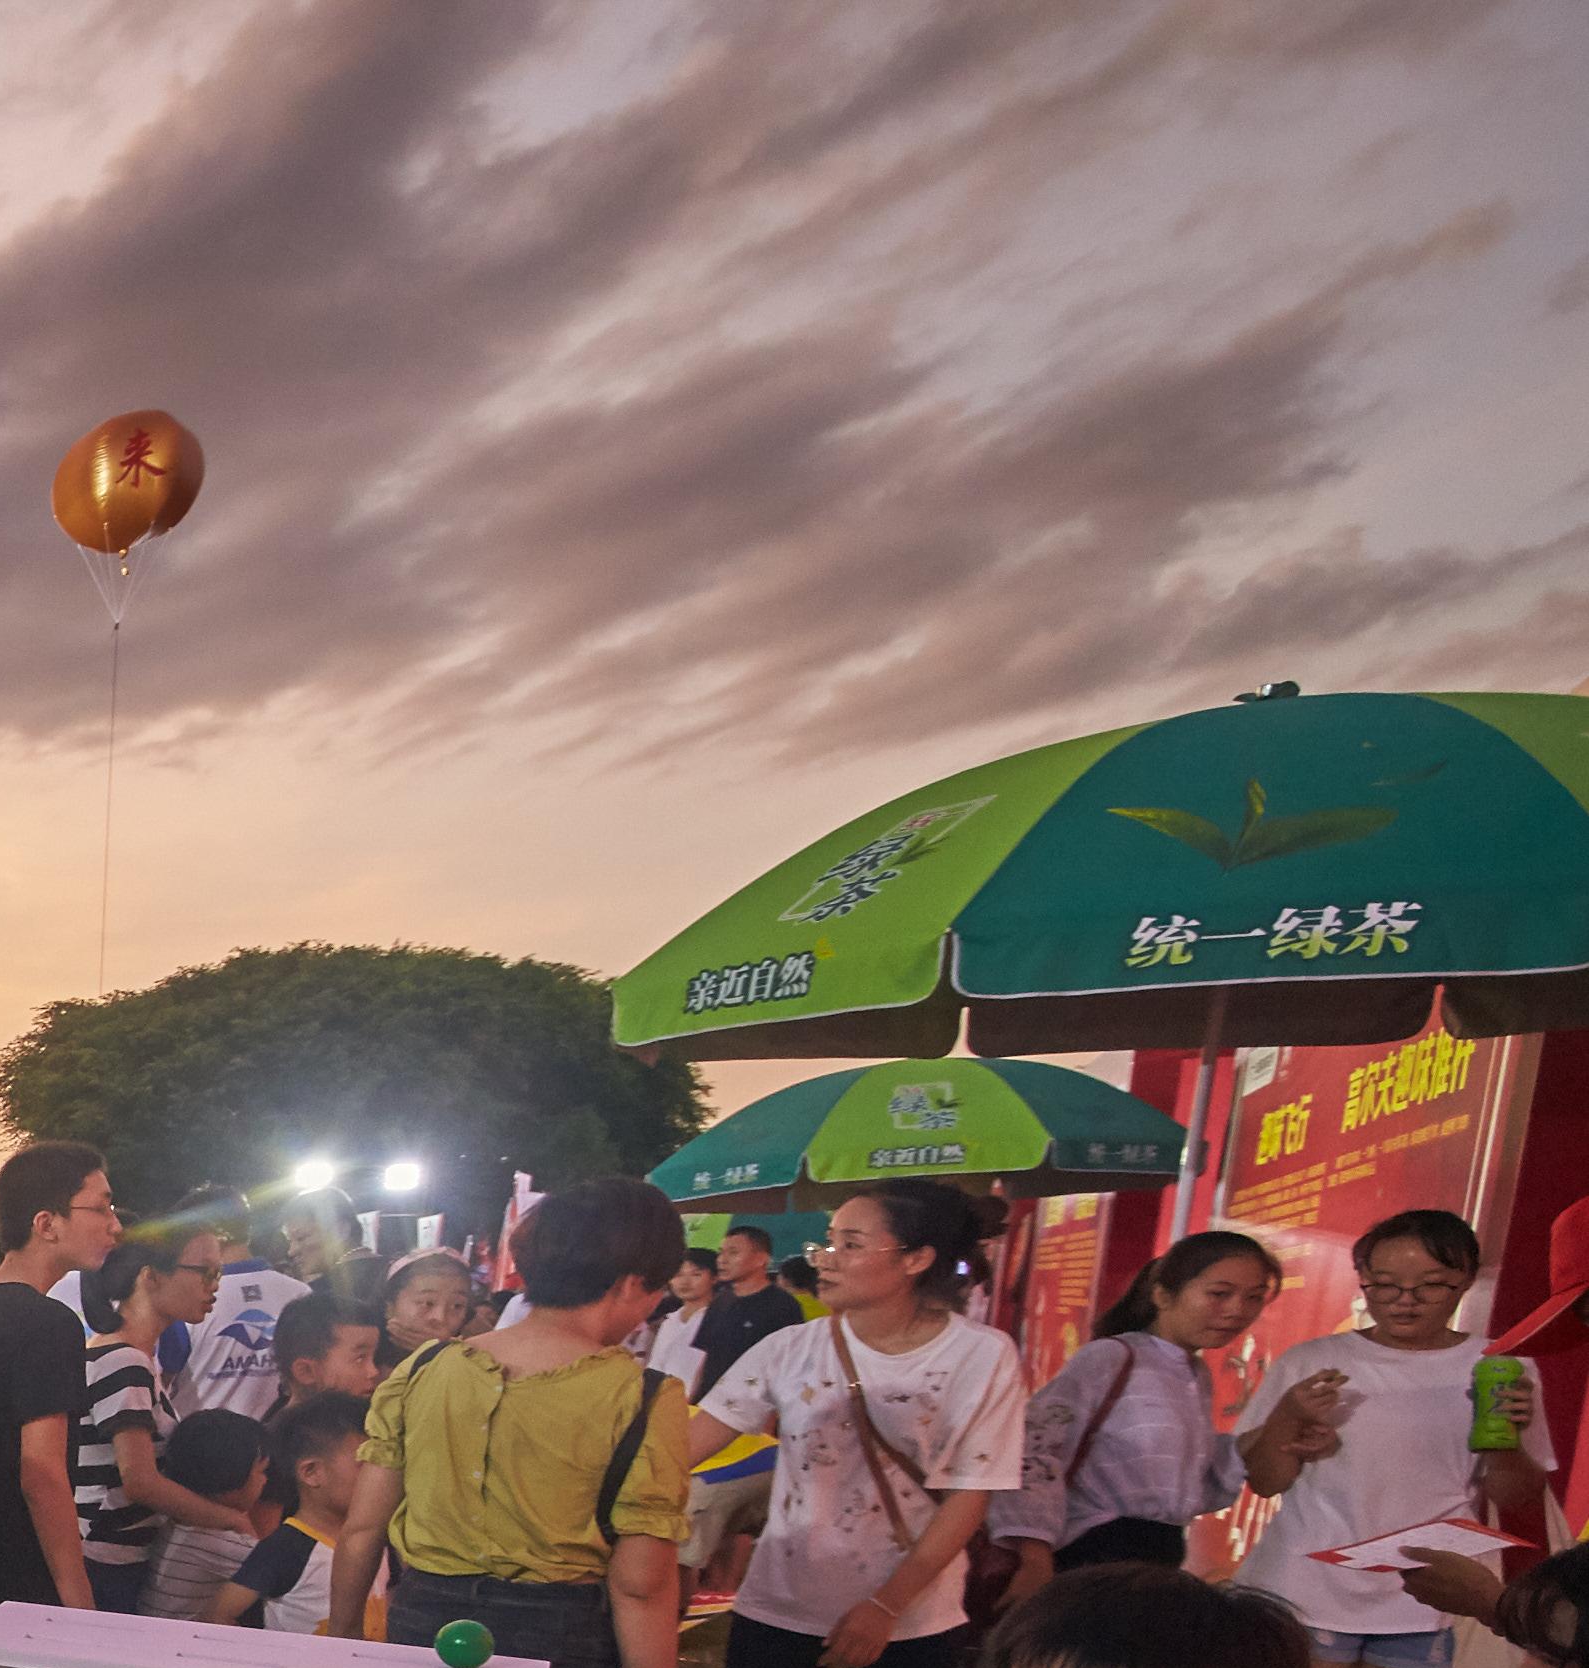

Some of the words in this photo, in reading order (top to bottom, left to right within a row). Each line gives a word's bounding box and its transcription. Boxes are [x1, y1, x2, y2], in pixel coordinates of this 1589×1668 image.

[1125, 901, 1423, 968] 统一绿茶
[684, 951, 816, 1013] 亲近自然
[869, 1144, 967, 1168] 亲近自然
